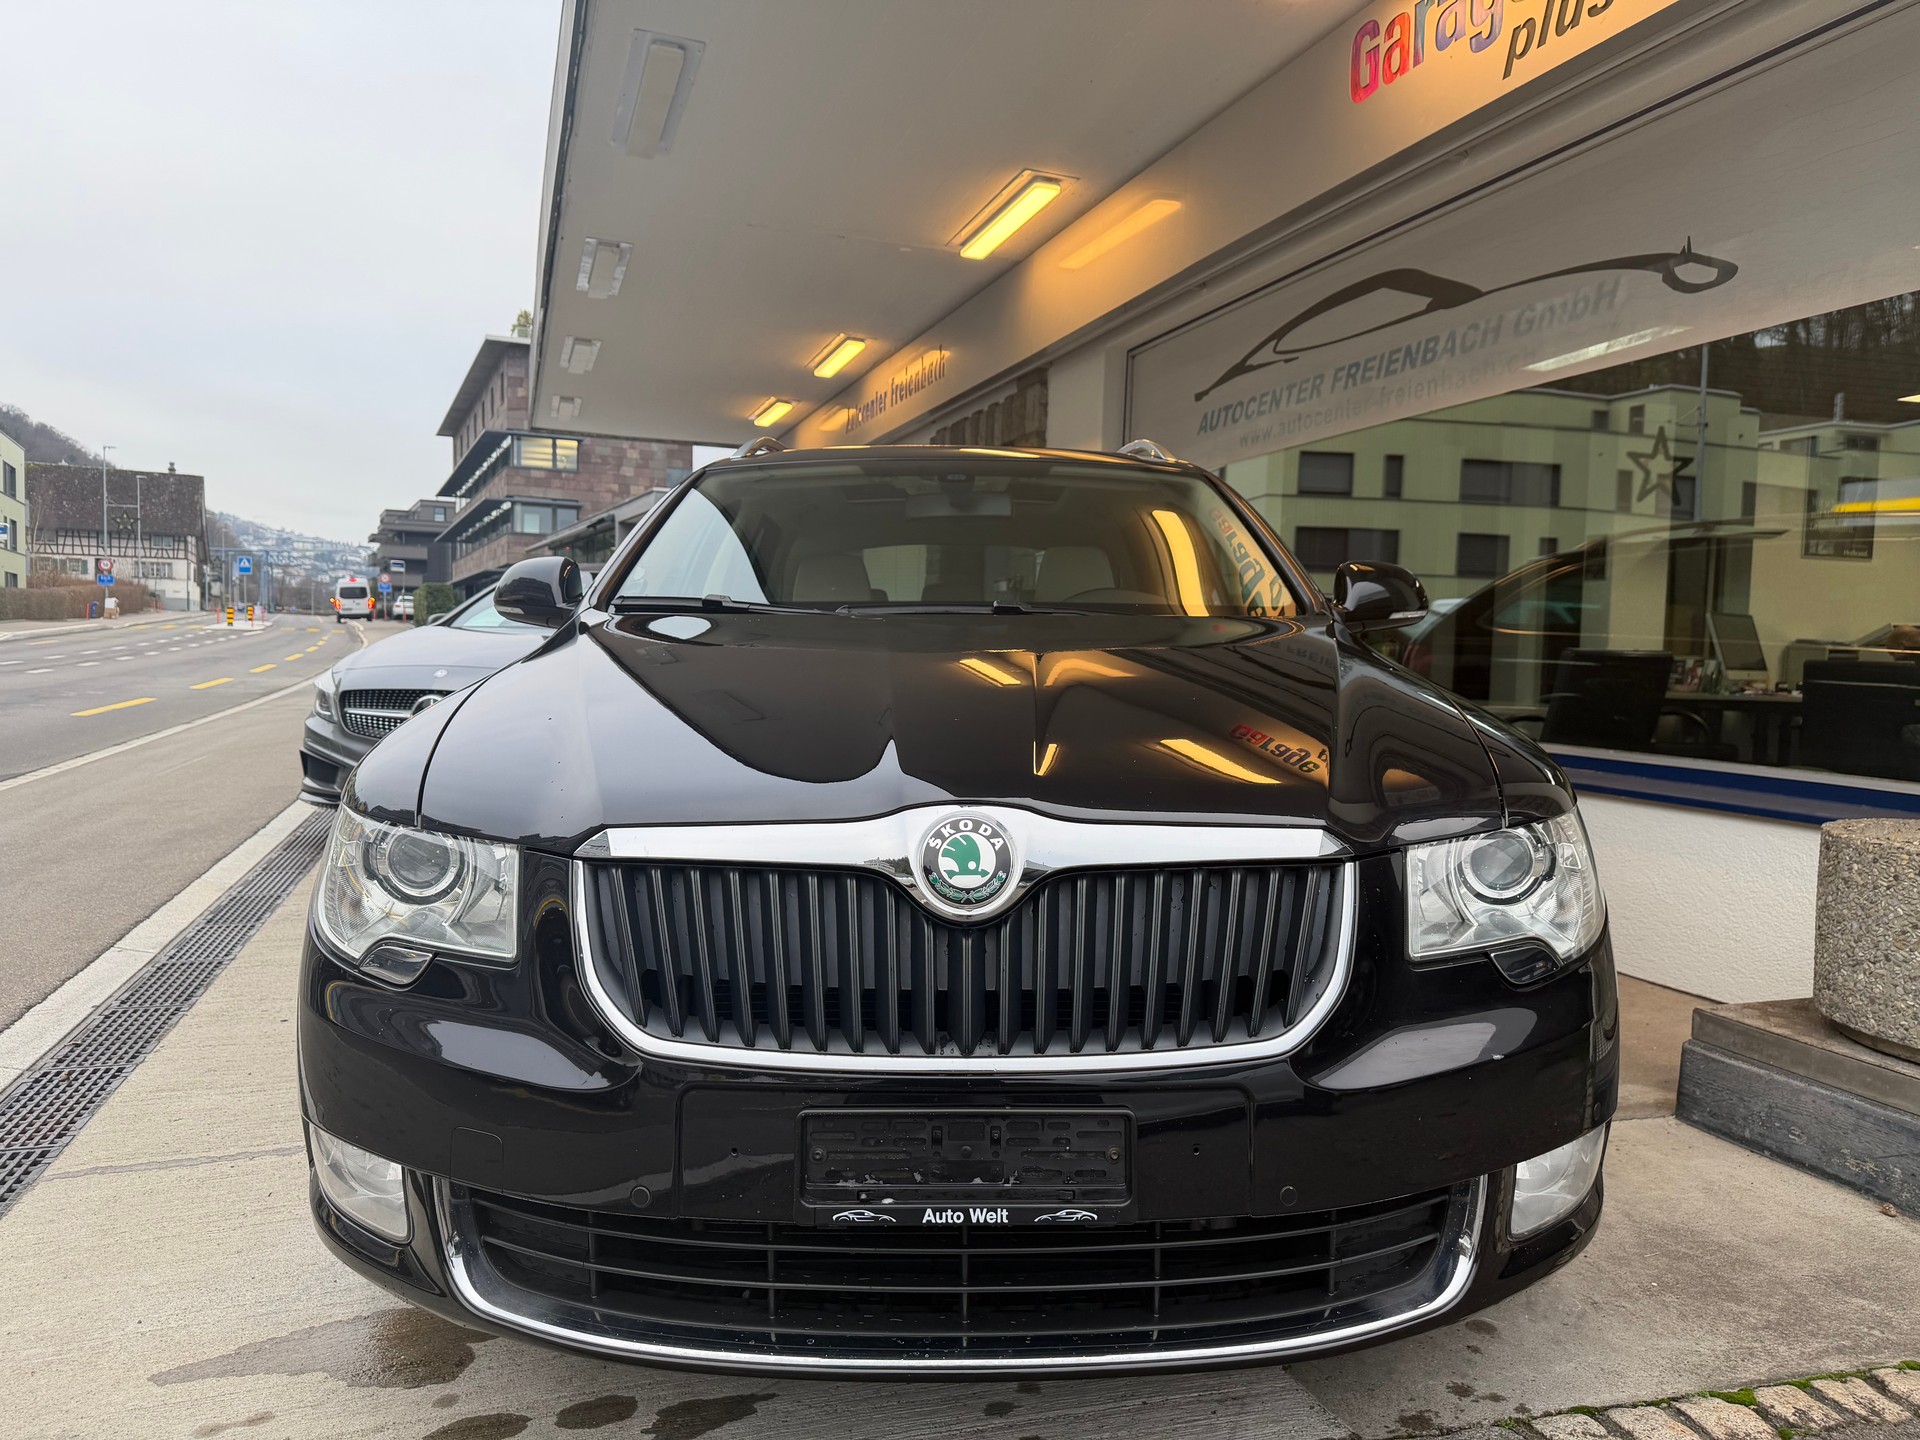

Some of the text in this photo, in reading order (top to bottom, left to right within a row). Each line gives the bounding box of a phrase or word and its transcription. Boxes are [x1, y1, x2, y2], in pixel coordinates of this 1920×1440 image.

[1350, 0, 1527, 104] Garag
[1197, 275, 1622, 435] AUTOCENTER FREIENBACH GmbH
[922, 1208, 1009, 1224] Auto Welt
